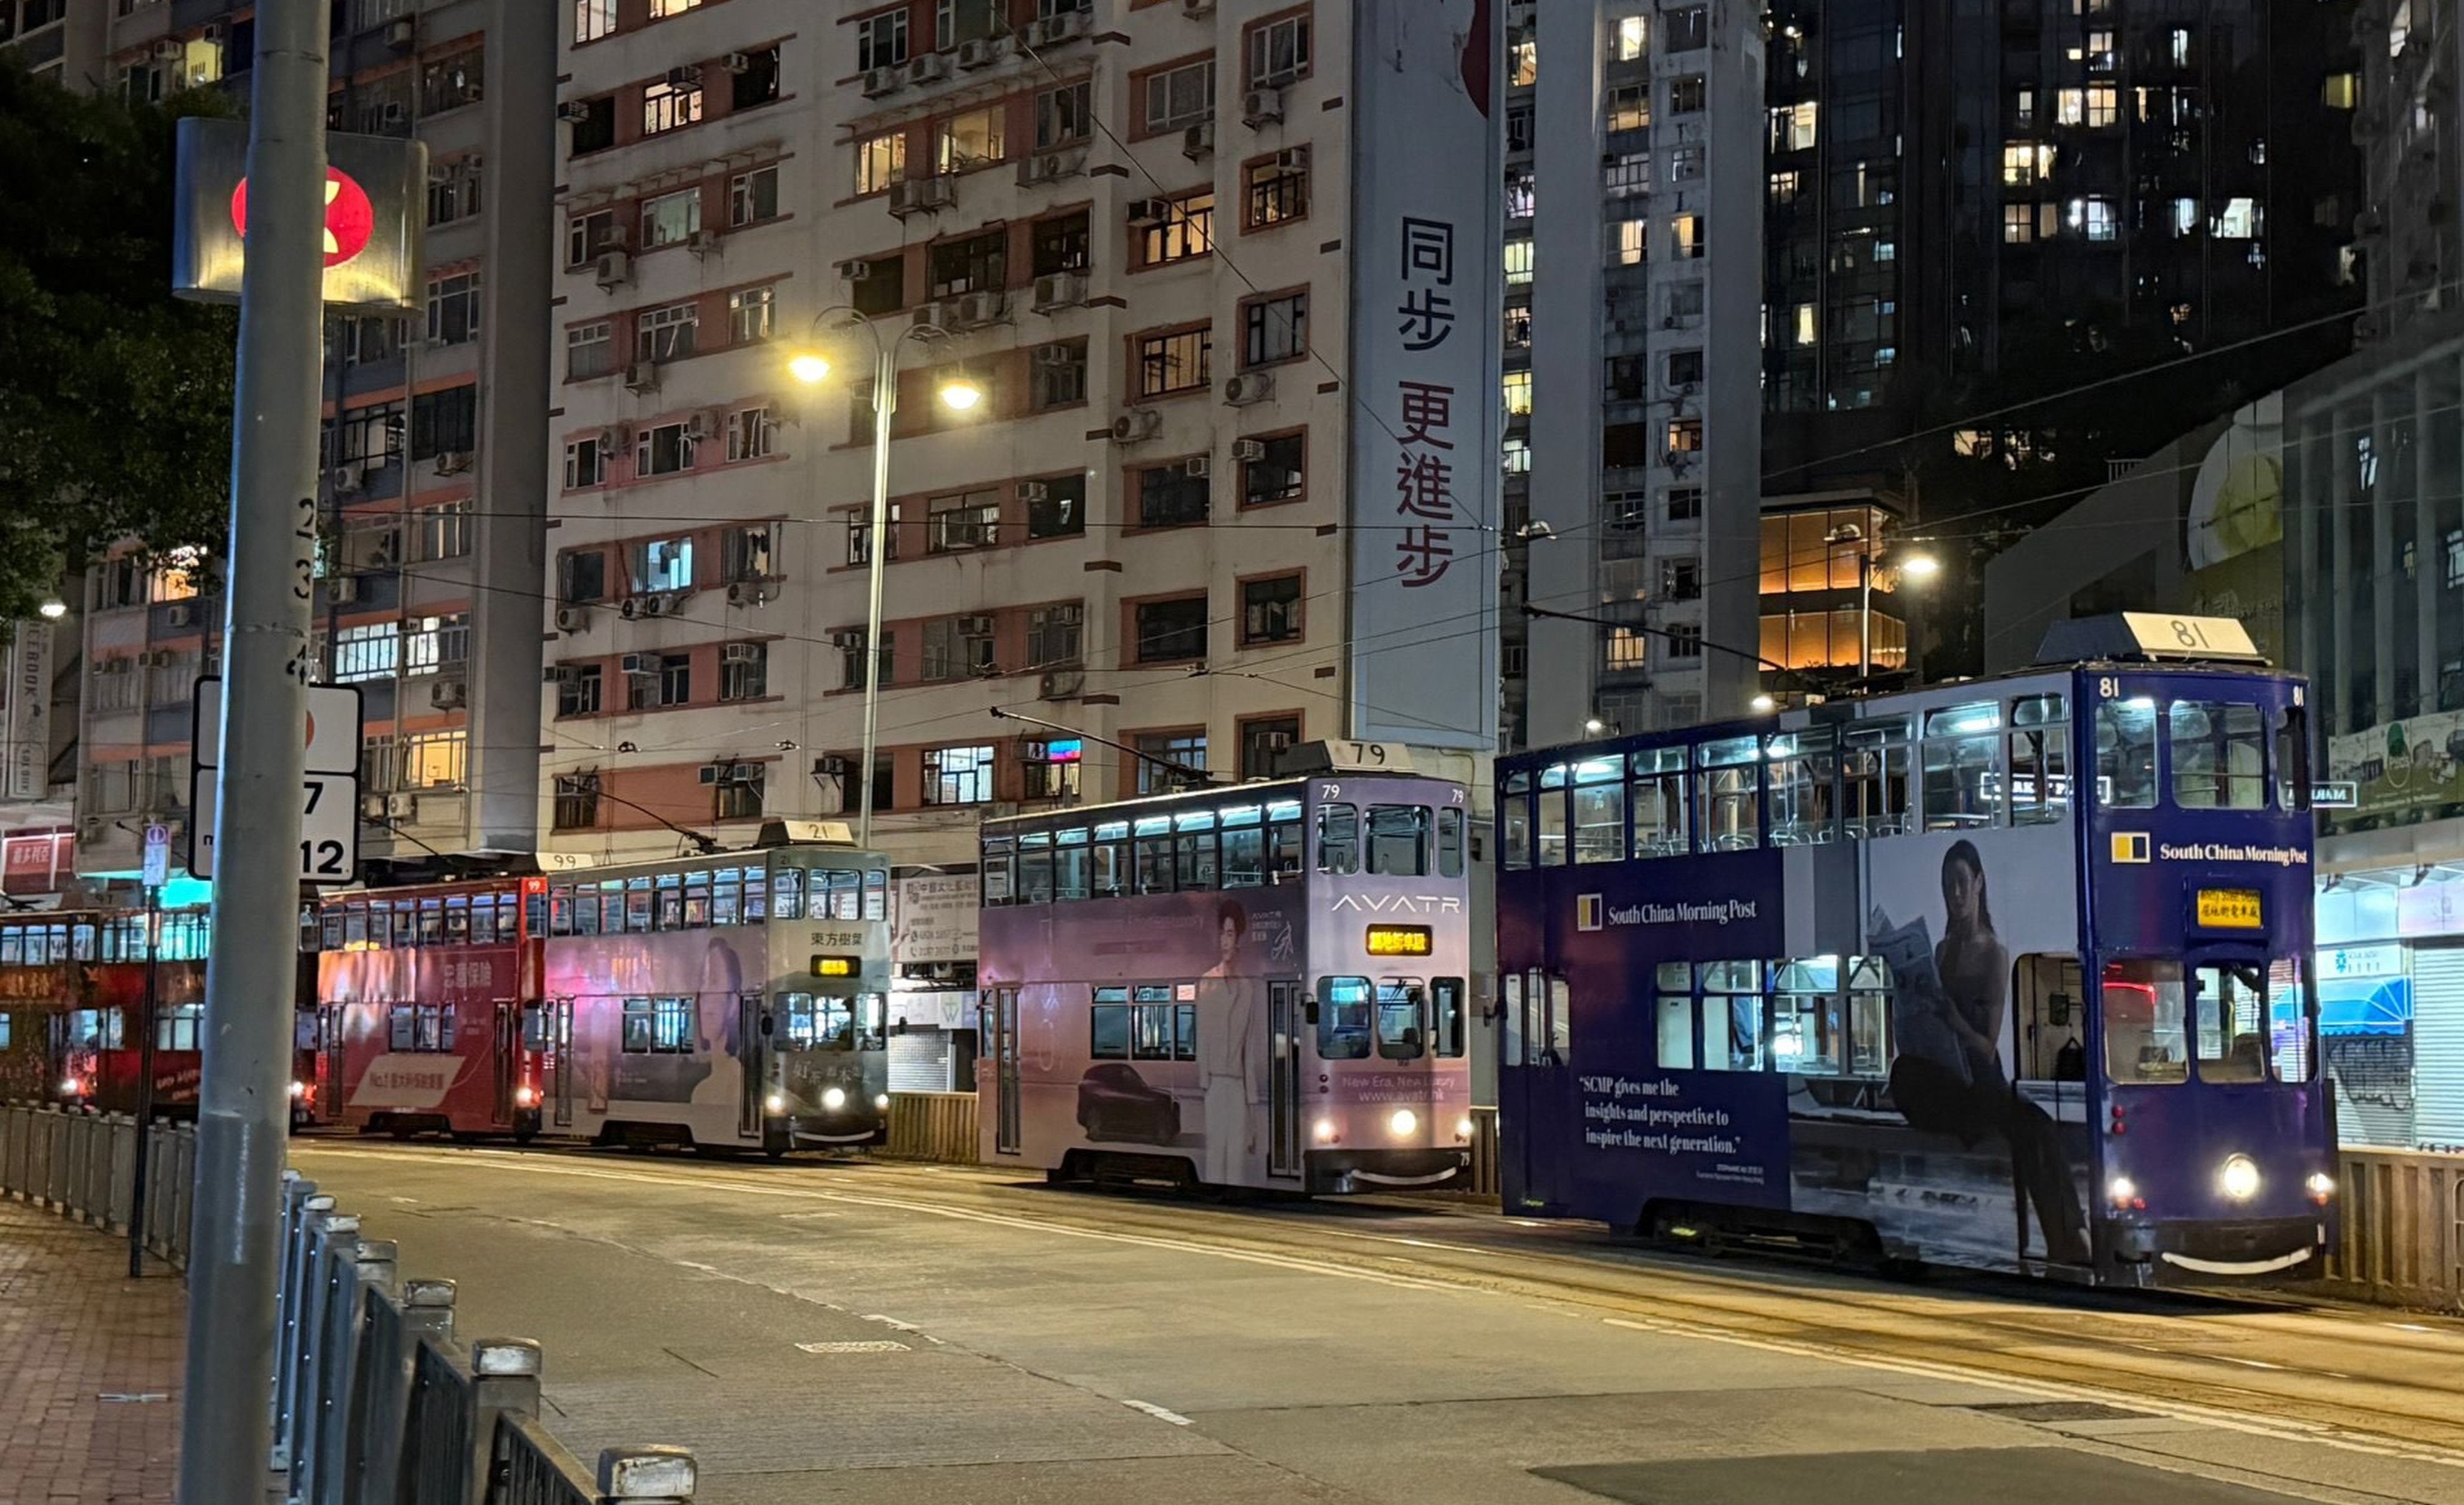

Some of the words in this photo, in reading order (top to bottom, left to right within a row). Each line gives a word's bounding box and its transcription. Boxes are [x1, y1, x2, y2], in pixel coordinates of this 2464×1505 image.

[2170, 620, 2209, 648] 81
[2099, 677, 2119, 698] 81
[2293, 685, 2304, 707] 81
[1350, 743, 1386, 765] 79
[1322, 784, 1340, 799] 79
[1452, 789, 1464, 803] 79
[809, 824, 829, 839] 21
[300, 840, 344, 874] 12
[554, 855, 576, 868] 99
[2160, 843, 2203, 860] South
[2205, 844, 2244, 861] China
[2245, 846, 2290, 867] Morning
[2290, 848, 2308, 864] Post
[528, 880, 540, 891] 99
[1332, 894, 1460, 914] AVATR
[1608, 905, 1640, 925] South
[1641, 903, 1675, 923] China
[1676, 899, 1729, 925] Morning
[1729, 899, 1757, 919] Post
[1615, 1077, 1641, 1098] gives
[1642, 1082, 1658, 1095] me
[1660, 1078, 1679, 1096] the
[1585, 1101, 1625, 1124] insights
[1627, 1103, 1647, 1121] and
[1649, 1106, 1714, 1128] perspective
[1716, 1109, 1729, 1126] to
[1586, 1127, 1623, 1150] inspire
[1625, 1129, 1642, 1147] the
[1643, 1134, 1668, 1150] next
